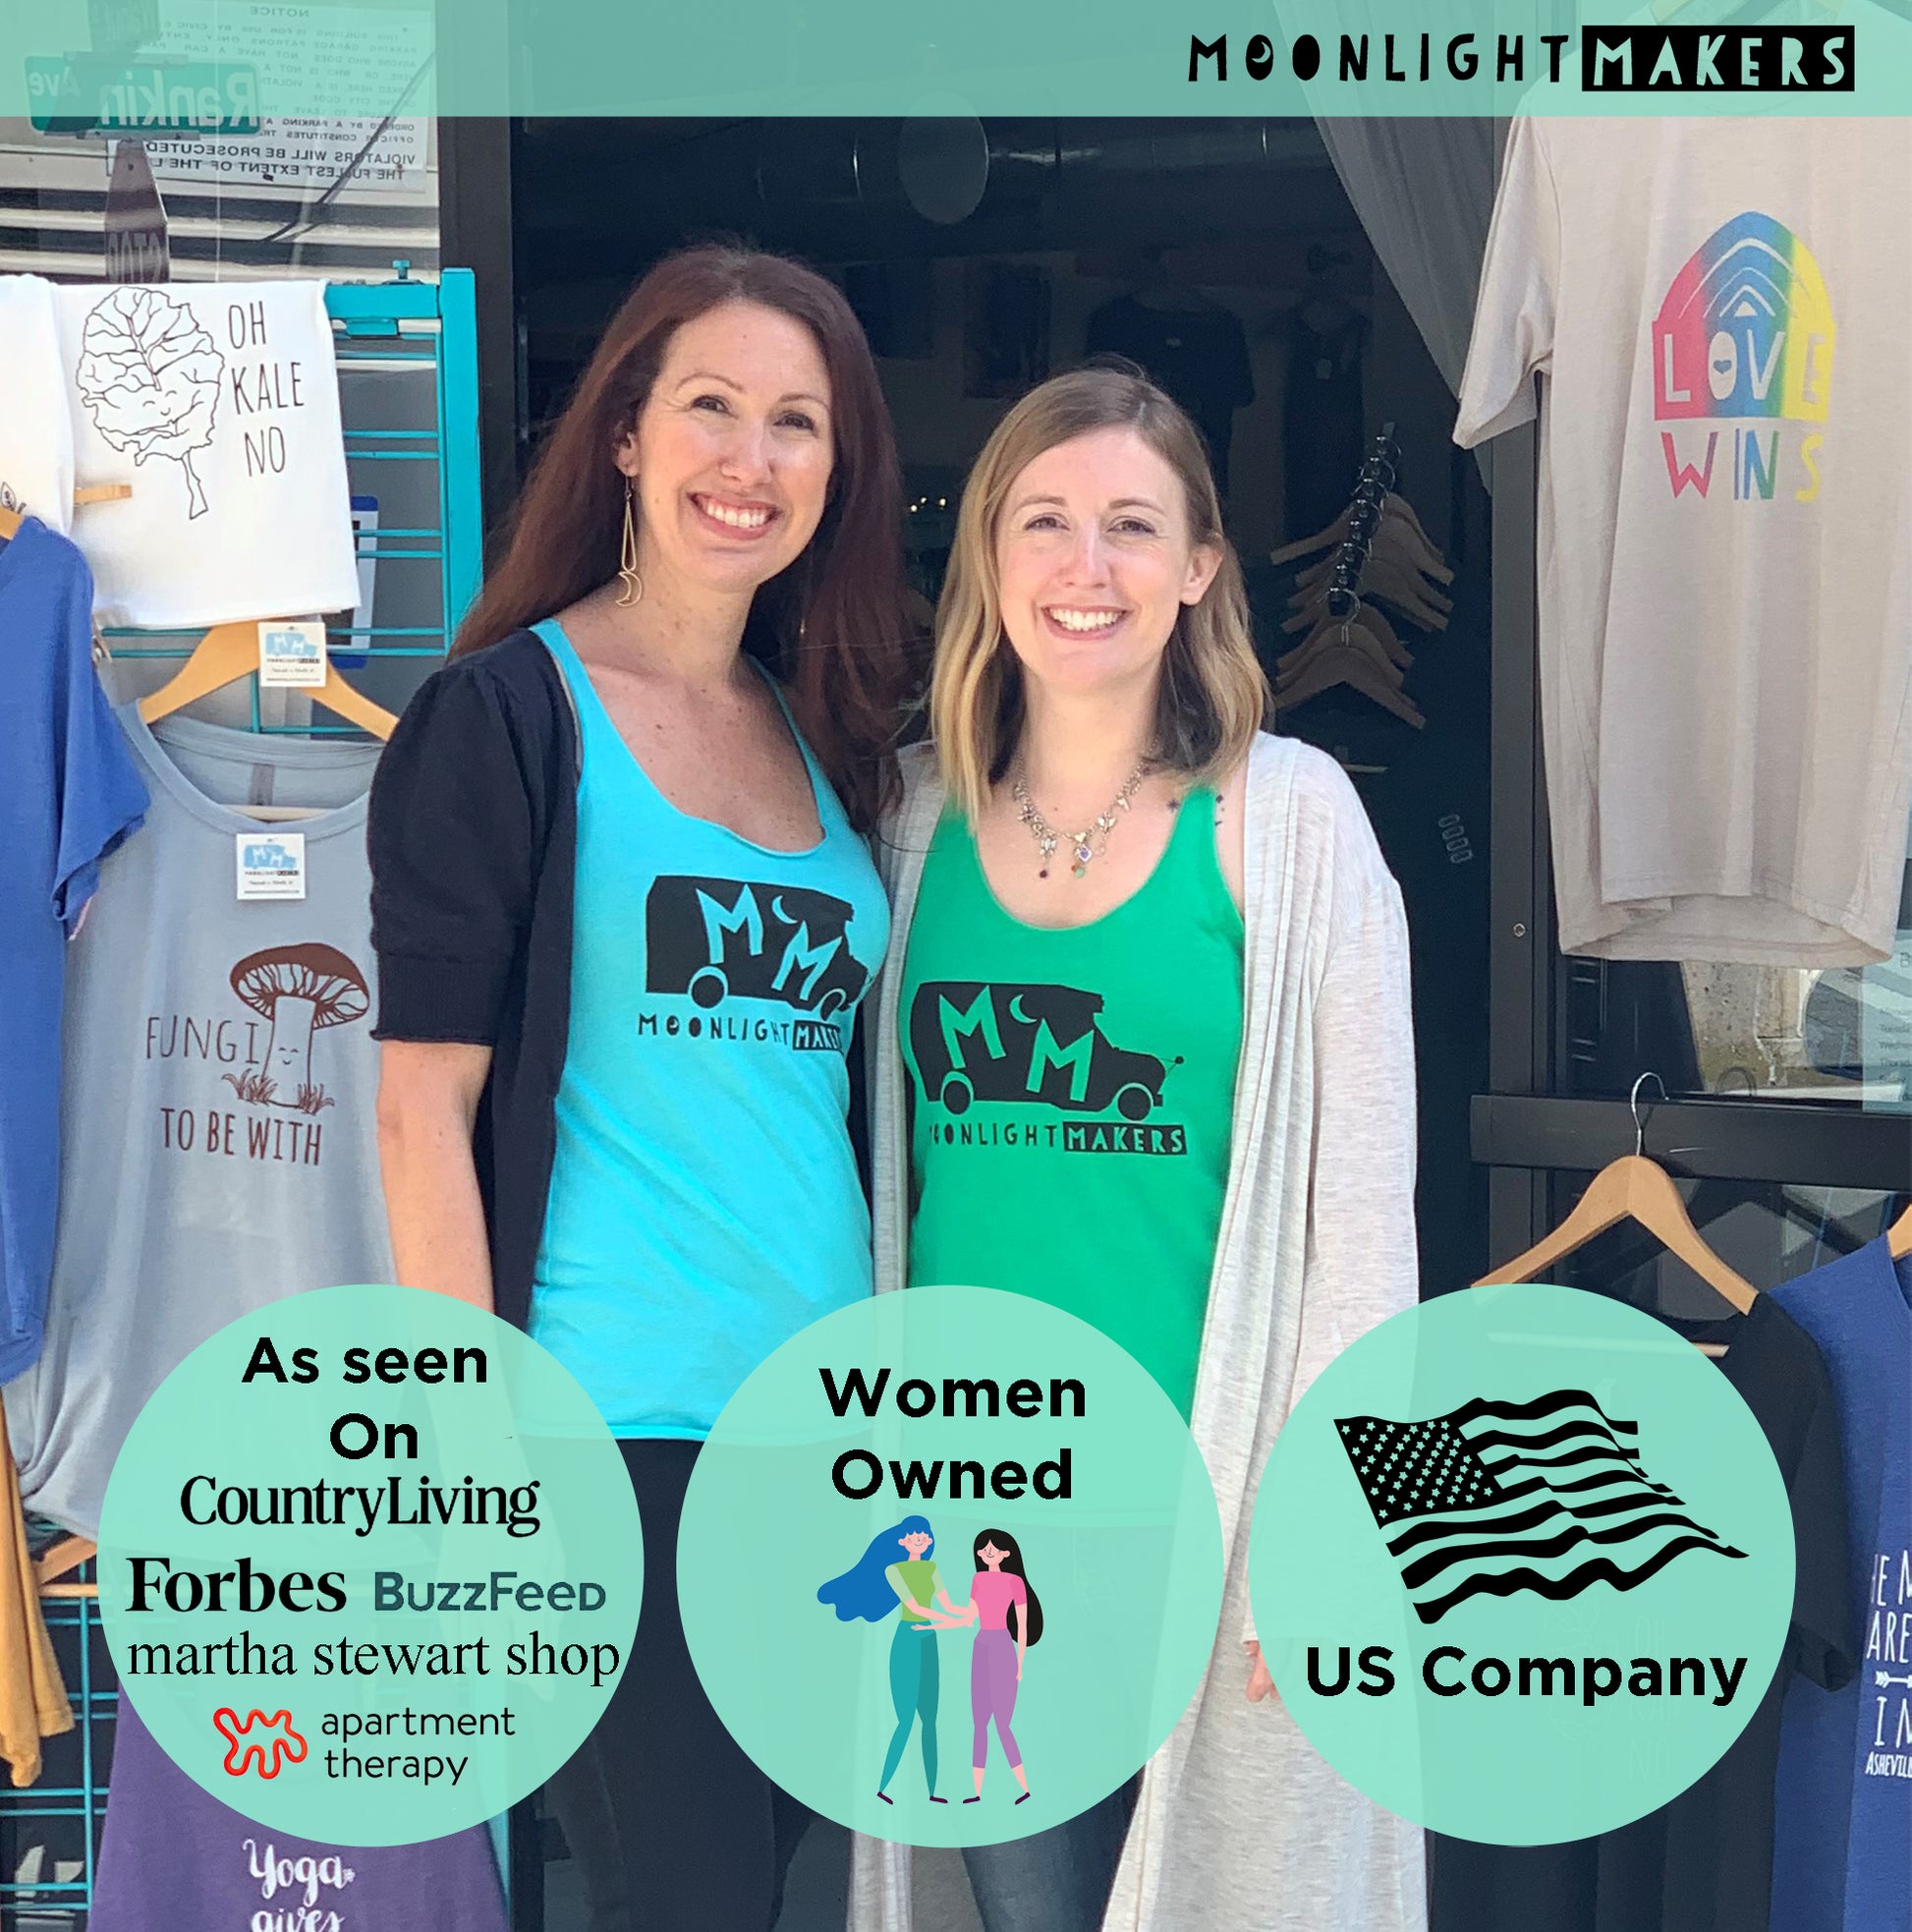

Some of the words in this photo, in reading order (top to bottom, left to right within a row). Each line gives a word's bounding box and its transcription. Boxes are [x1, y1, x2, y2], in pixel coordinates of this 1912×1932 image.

[228, 301, 266, 349] OH
[231, 362, 305, 415] KALE
[1663, 330, 1828, 405] LOVE
[245, 426, 286, 477] NO
[1660, 430, 1824, 504] WINS
[146, 1016, 259, 1064] FUNGI
[639, 1013, 790, 1046] MOONLIGHT
[161, 1108, 195, 1151] TO
[207, 1113, 235, 1156] BE
[248, 1116, 322, 1166] WITH
[1068, 1126, 1182, 1153] MAKERS
[243, 1839, 350, 1907] Yoga
